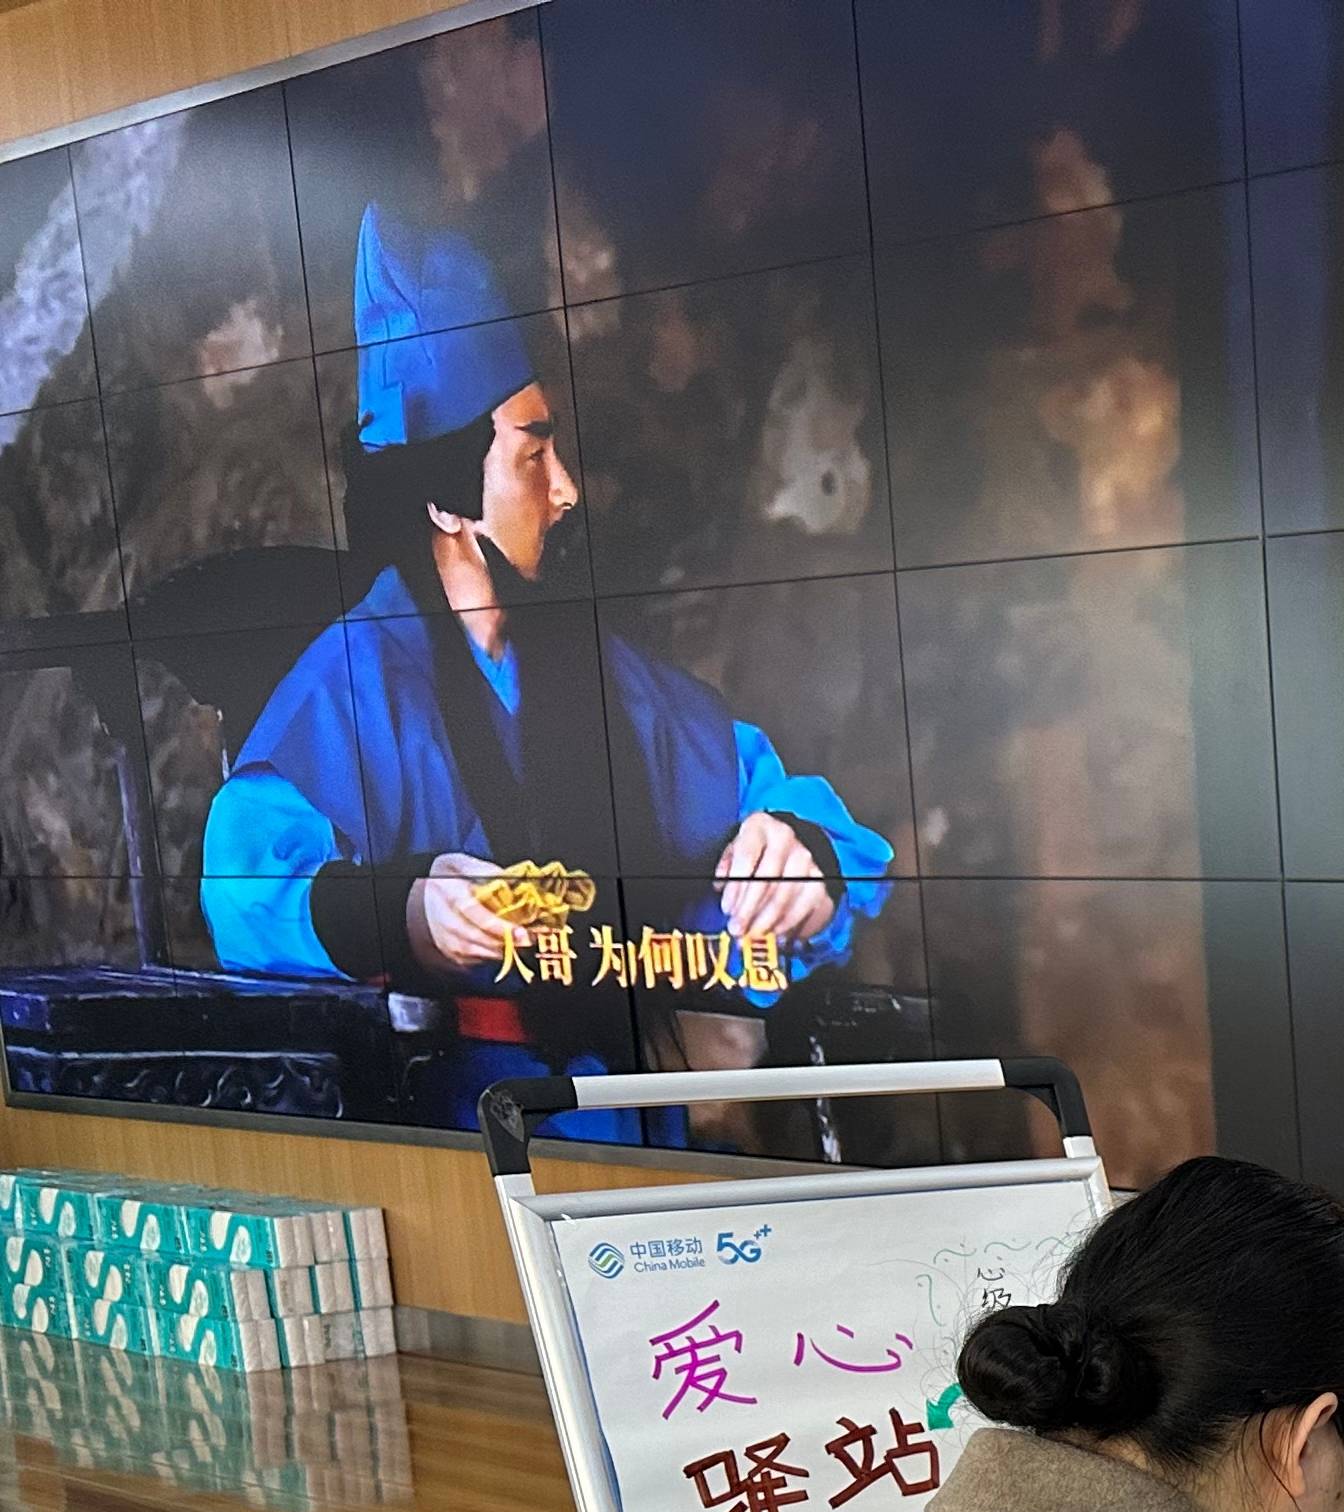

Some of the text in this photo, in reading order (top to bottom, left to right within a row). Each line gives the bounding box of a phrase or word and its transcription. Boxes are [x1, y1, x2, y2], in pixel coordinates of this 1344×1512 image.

[589, 925, 788, 991] 为何叹息
[630, 1237, 704, 1260] 中国移动
[633, 1257, 706, 1273] China Mobile
[648, 1299, 914, 1420] 爱心
